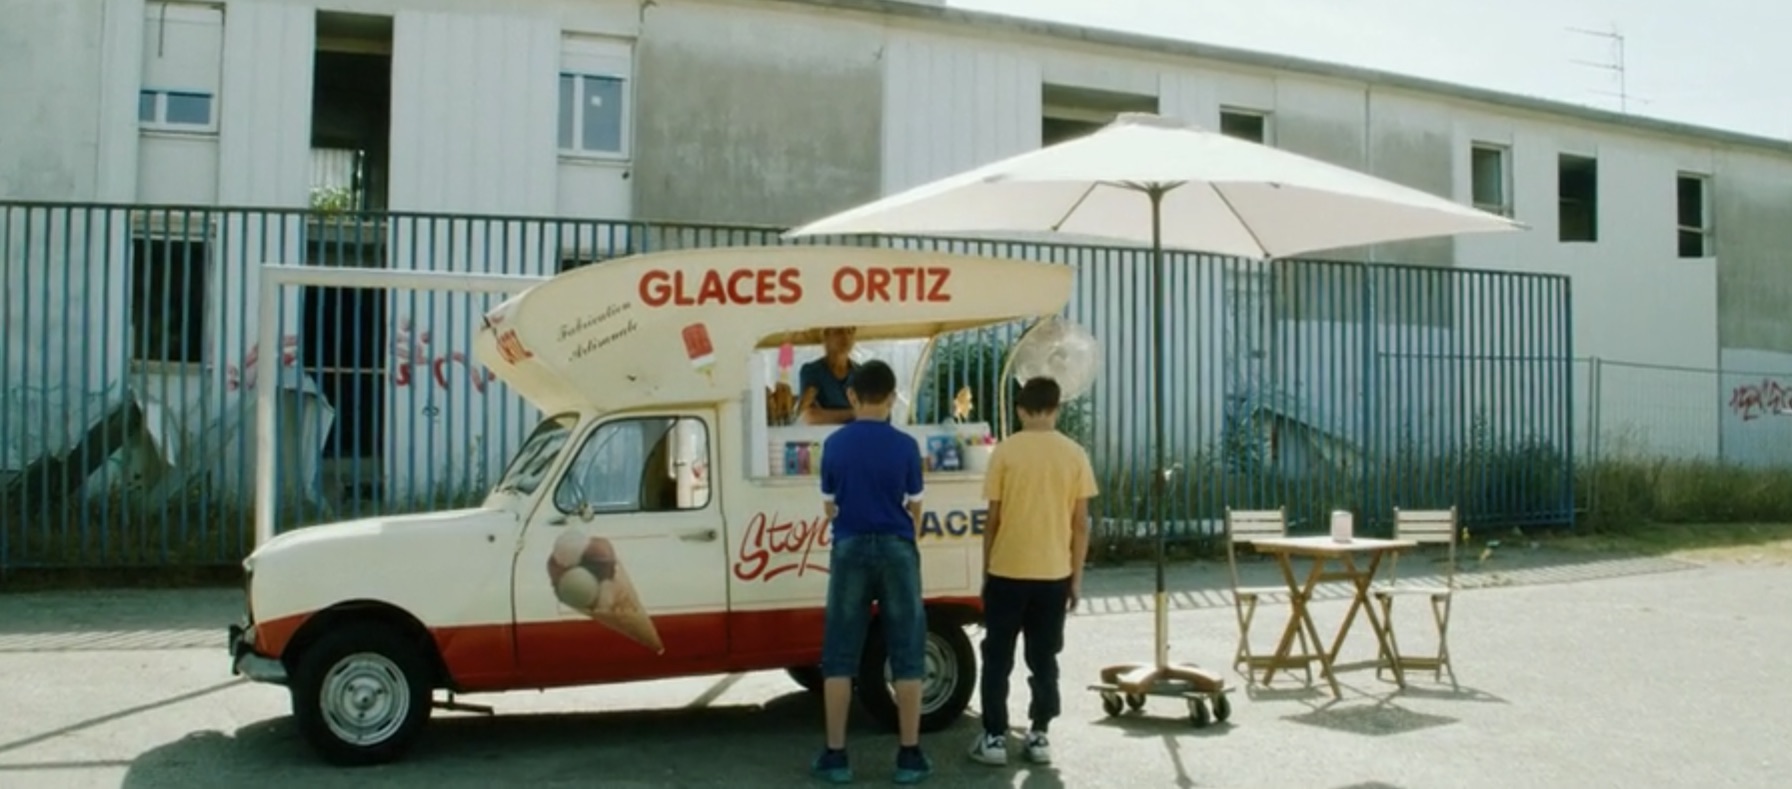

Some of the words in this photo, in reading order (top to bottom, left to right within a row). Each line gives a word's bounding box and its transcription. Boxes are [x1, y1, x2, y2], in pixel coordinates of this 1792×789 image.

[639, 268, 803, 307] GLACES
[832, 266, 952, 303] ORTIZ
[919, 509, 988, 538] ACE
